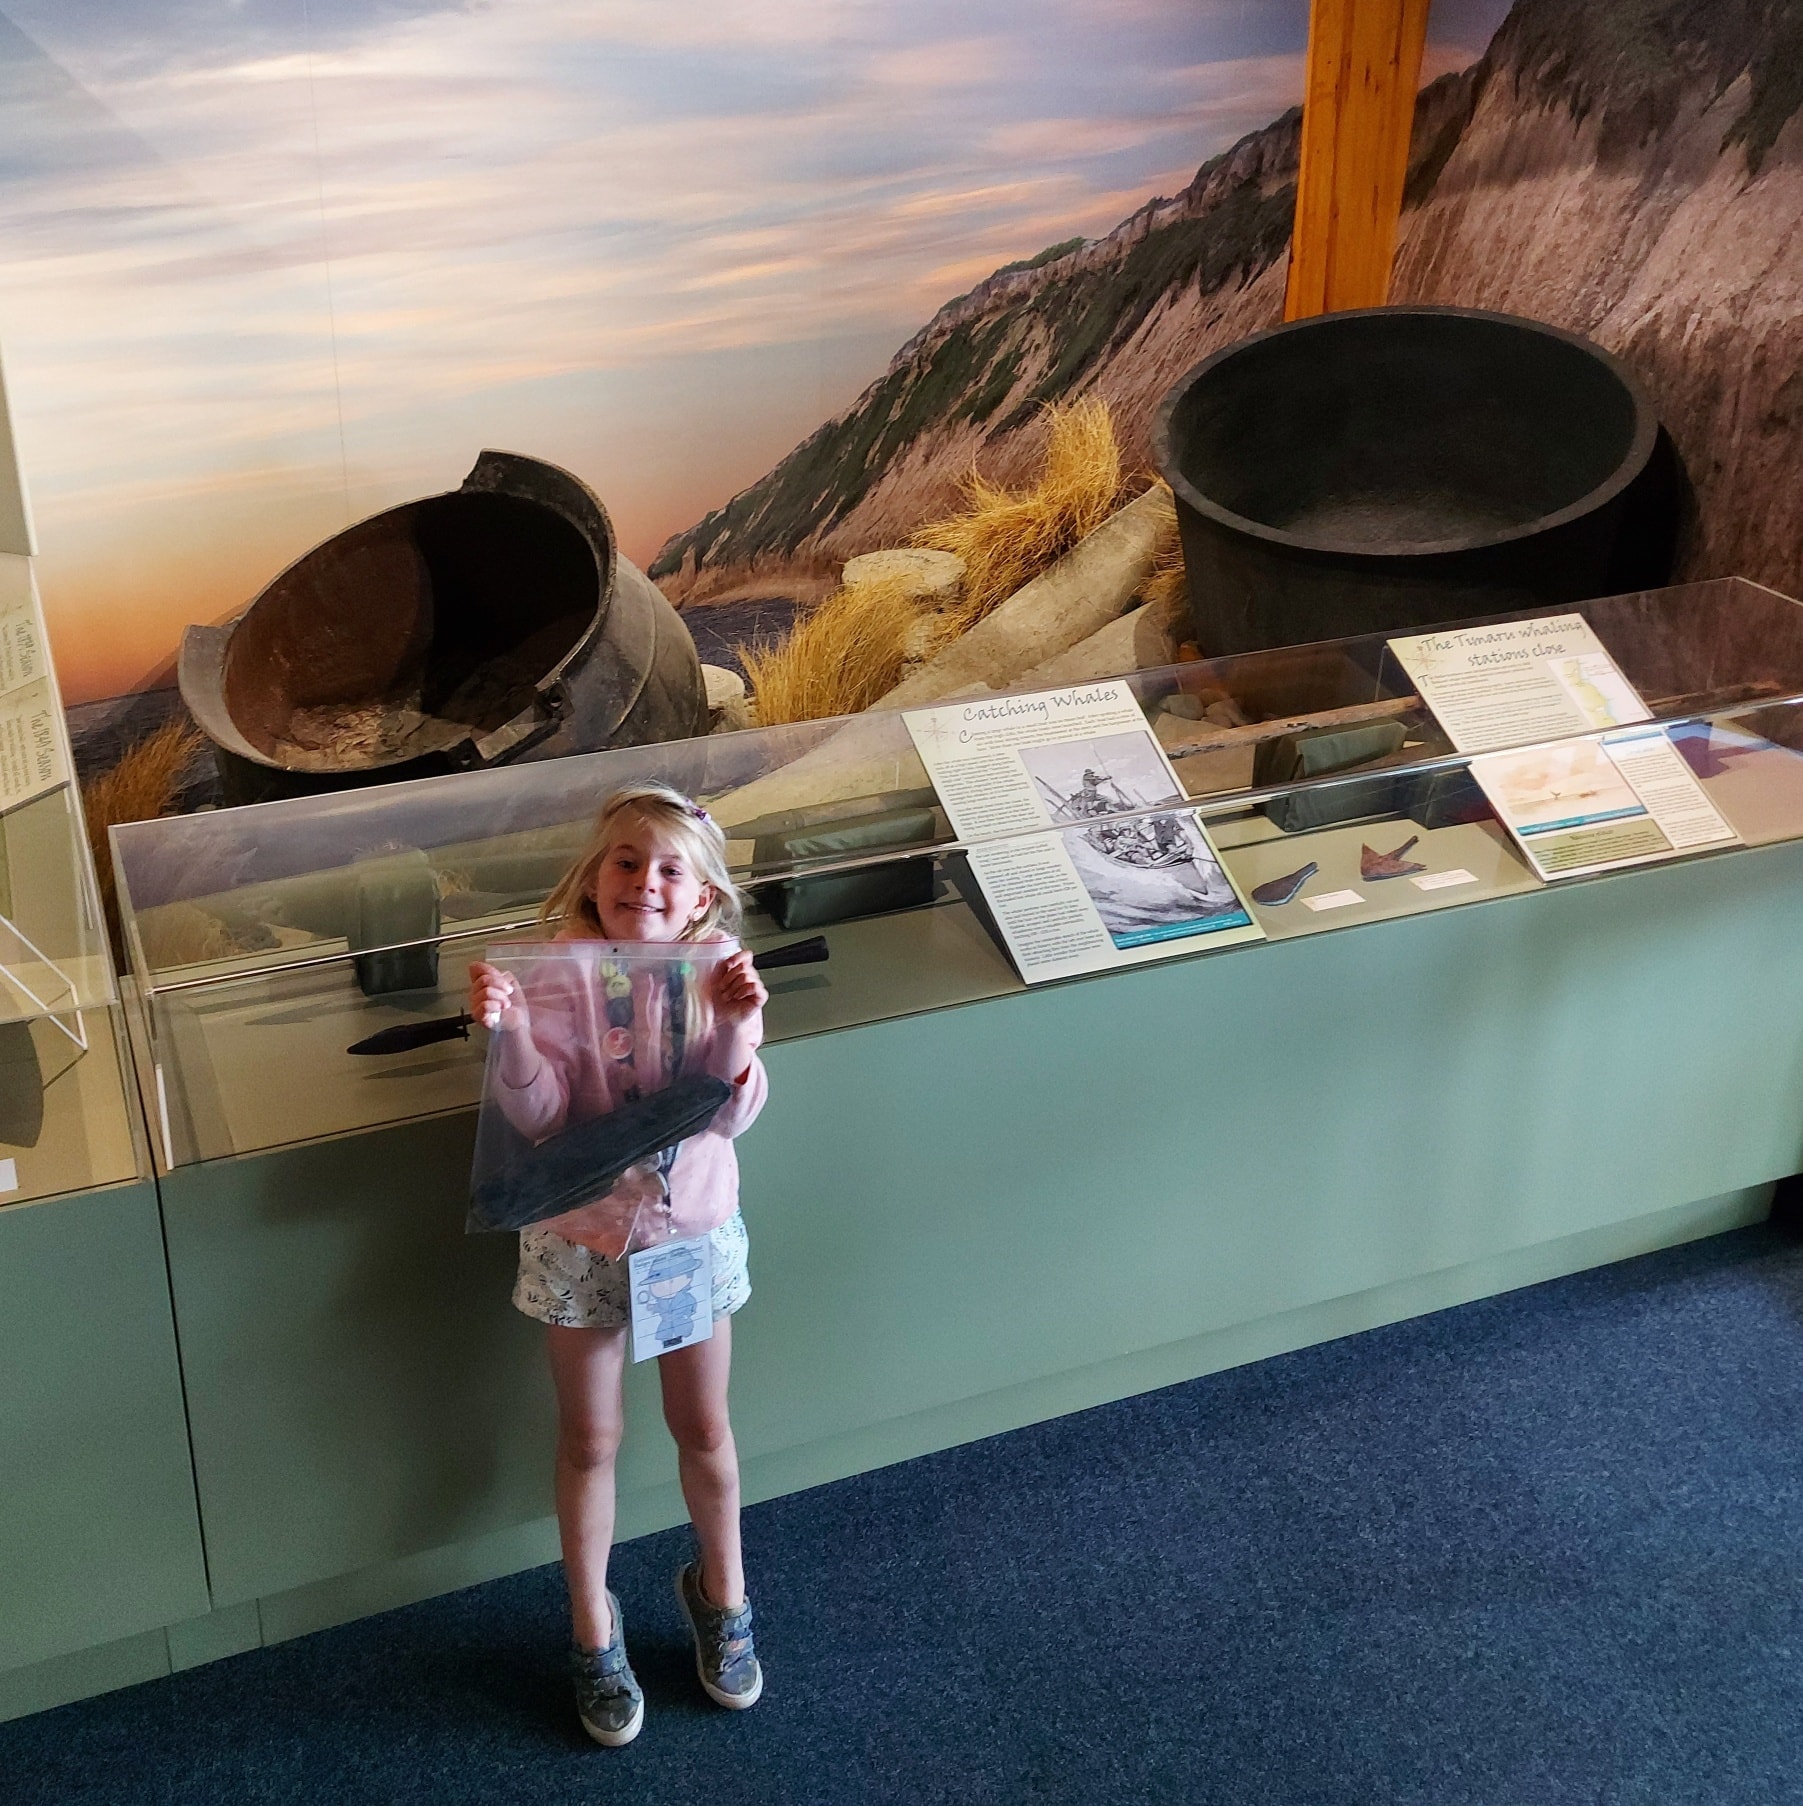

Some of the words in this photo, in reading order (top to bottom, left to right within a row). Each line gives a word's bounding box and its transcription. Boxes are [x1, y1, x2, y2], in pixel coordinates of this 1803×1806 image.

[1421, 636, 1454, 651] The
[1453, 632, 1516, 647] Timaru
[1467, 648, 1530, 666] stations
[1532, 643, 1566, 657] close
[963, 699, 1049, 721] Catching
[1049, 688, 1118, 707] Whales
[31, 710, 52, 730] The
